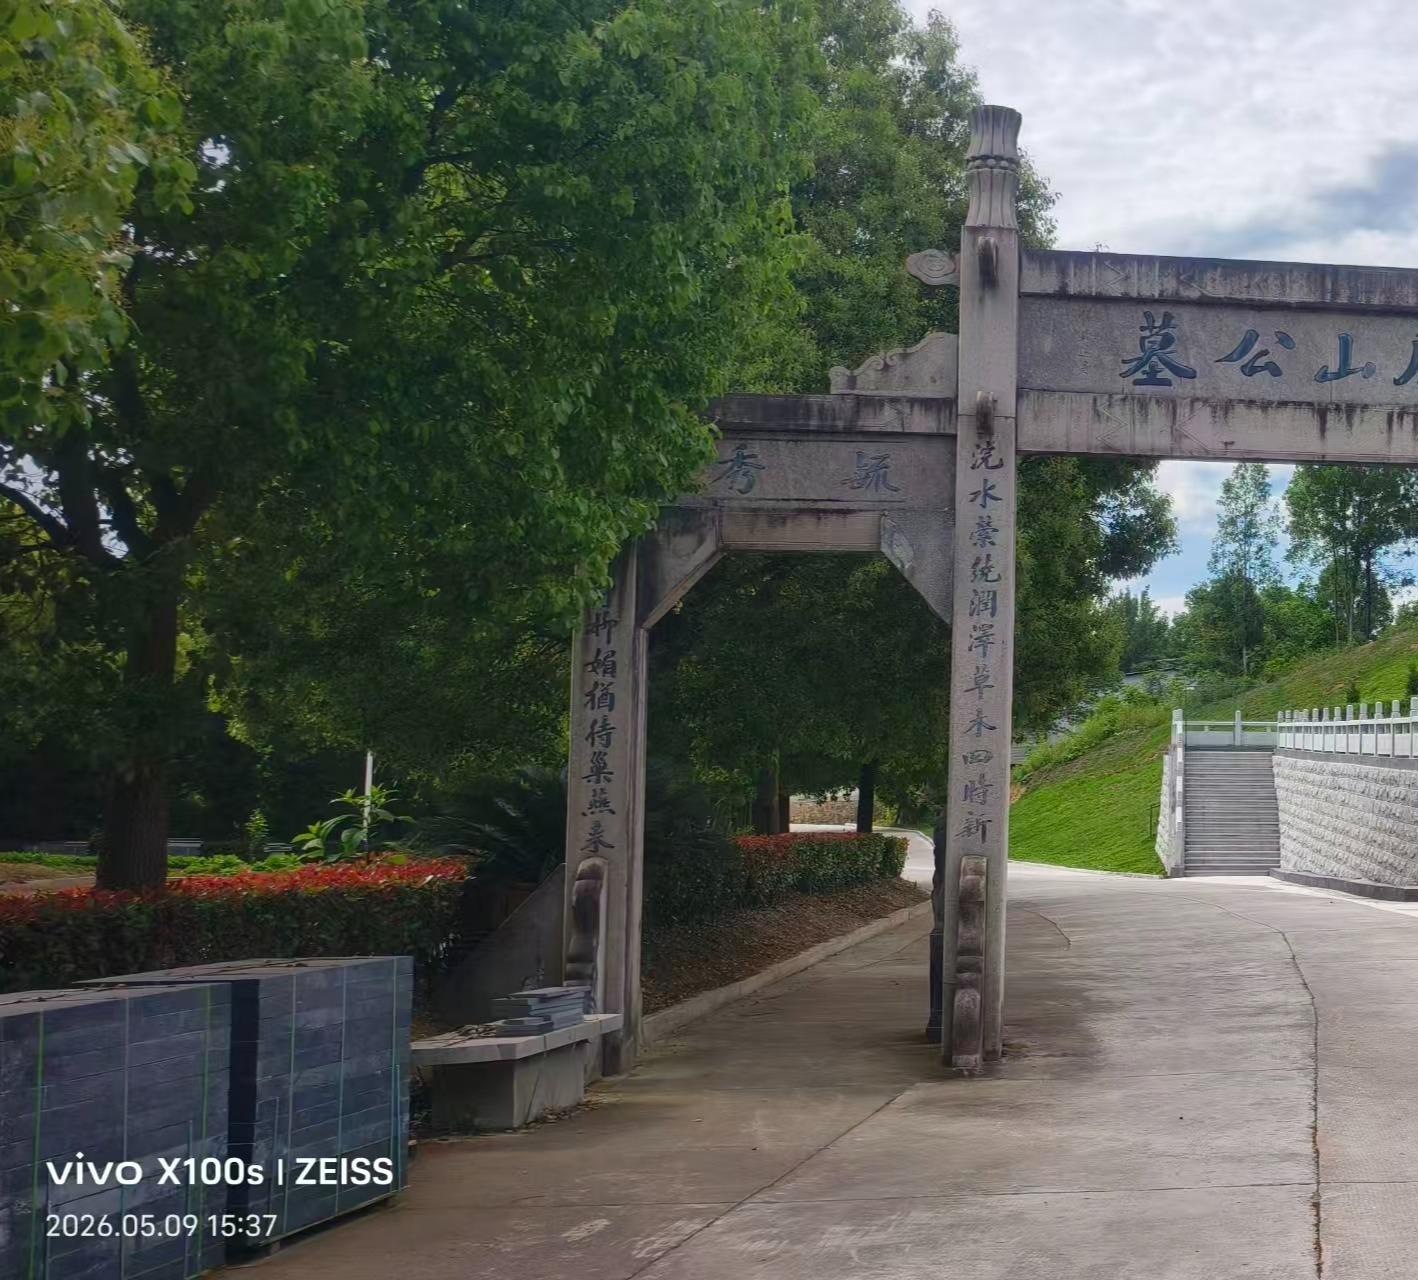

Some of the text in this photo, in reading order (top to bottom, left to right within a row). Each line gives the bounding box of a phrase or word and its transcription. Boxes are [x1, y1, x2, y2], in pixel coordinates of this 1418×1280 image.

[581, 592, 618, 852] 柳媚猶待巢燕來
